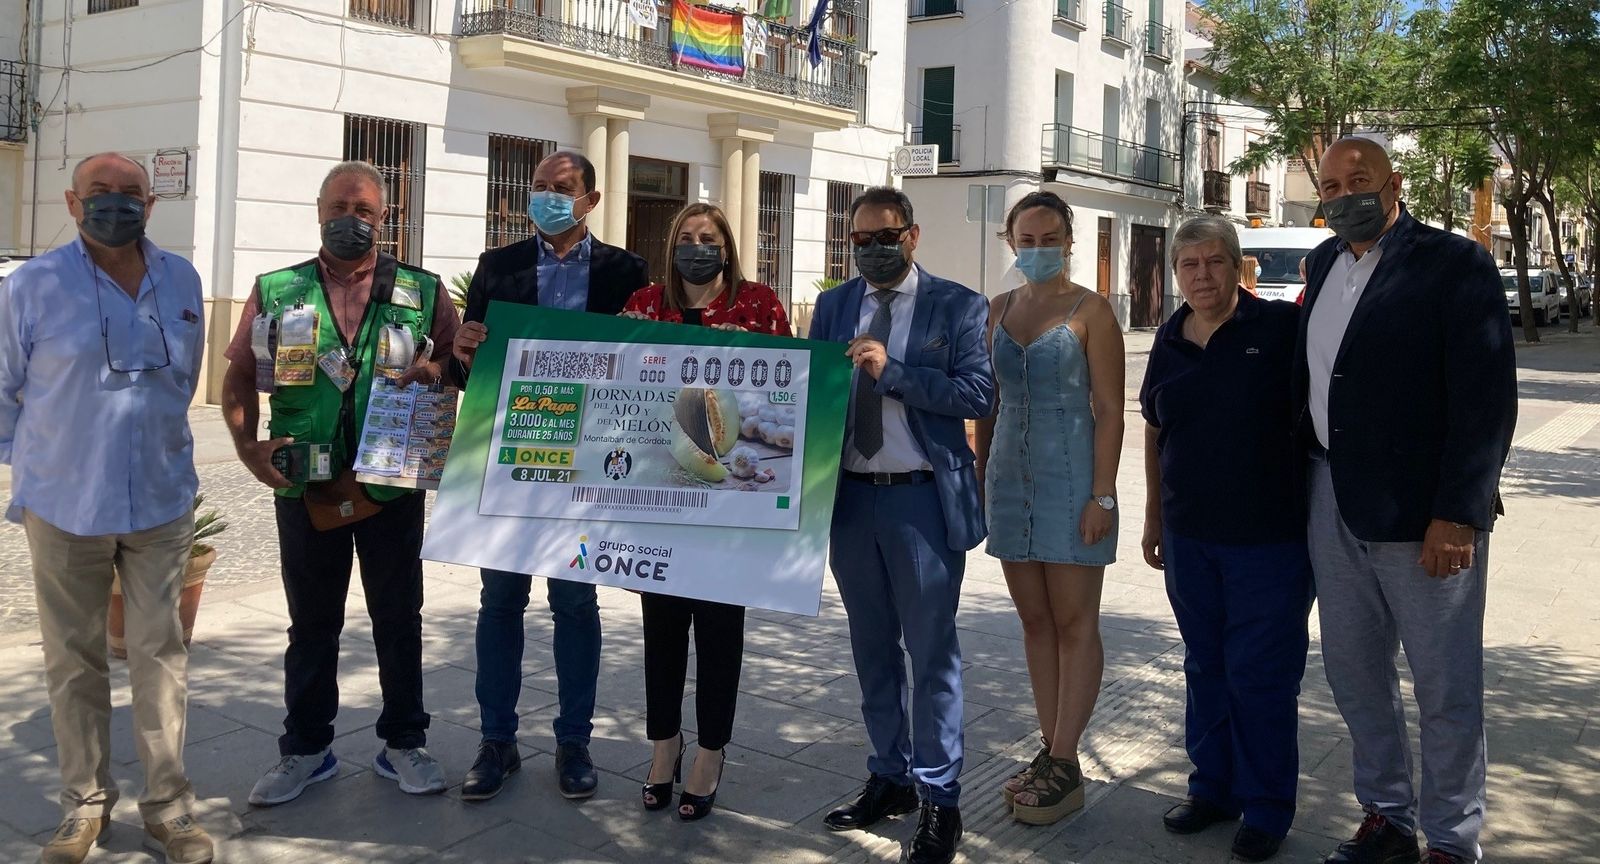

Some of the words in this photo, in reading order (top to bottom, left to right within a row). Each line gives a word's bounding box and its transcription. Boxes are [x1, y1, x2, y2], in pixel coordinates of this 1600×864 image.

[643, 356, 667, 365] SERIE
[639, 369, 666, 384] 000
[520, 385, 533, 393] POR
[560, 385, 575, 395] MÁS
[590, 388, 676, 403] JORNADAS
[610, 403, 640, 418] AJO
[644, 408, 651, 416] Y
[558, 419, 576, 429] MES
[612, 417, 673, 433] MELÓN
[507, 428, 541, 439] DURANTE
[541, 430, 552, 440] 25
[552, 429, 574, 440] AÑOS
[583, 434, 624, 443] Montalbán
[625, 436, 637, 444] de
[520, 450, 570, 464] ONCE
[520, 468, 528, 481] 8
[530, 469, 555, 482] JUL.
[557, 470, 571, 483] 21
[598, 540, 635, 553] grupo
[637, 545, 673, 558] social
[594, 554, 669, 581] ONCE
